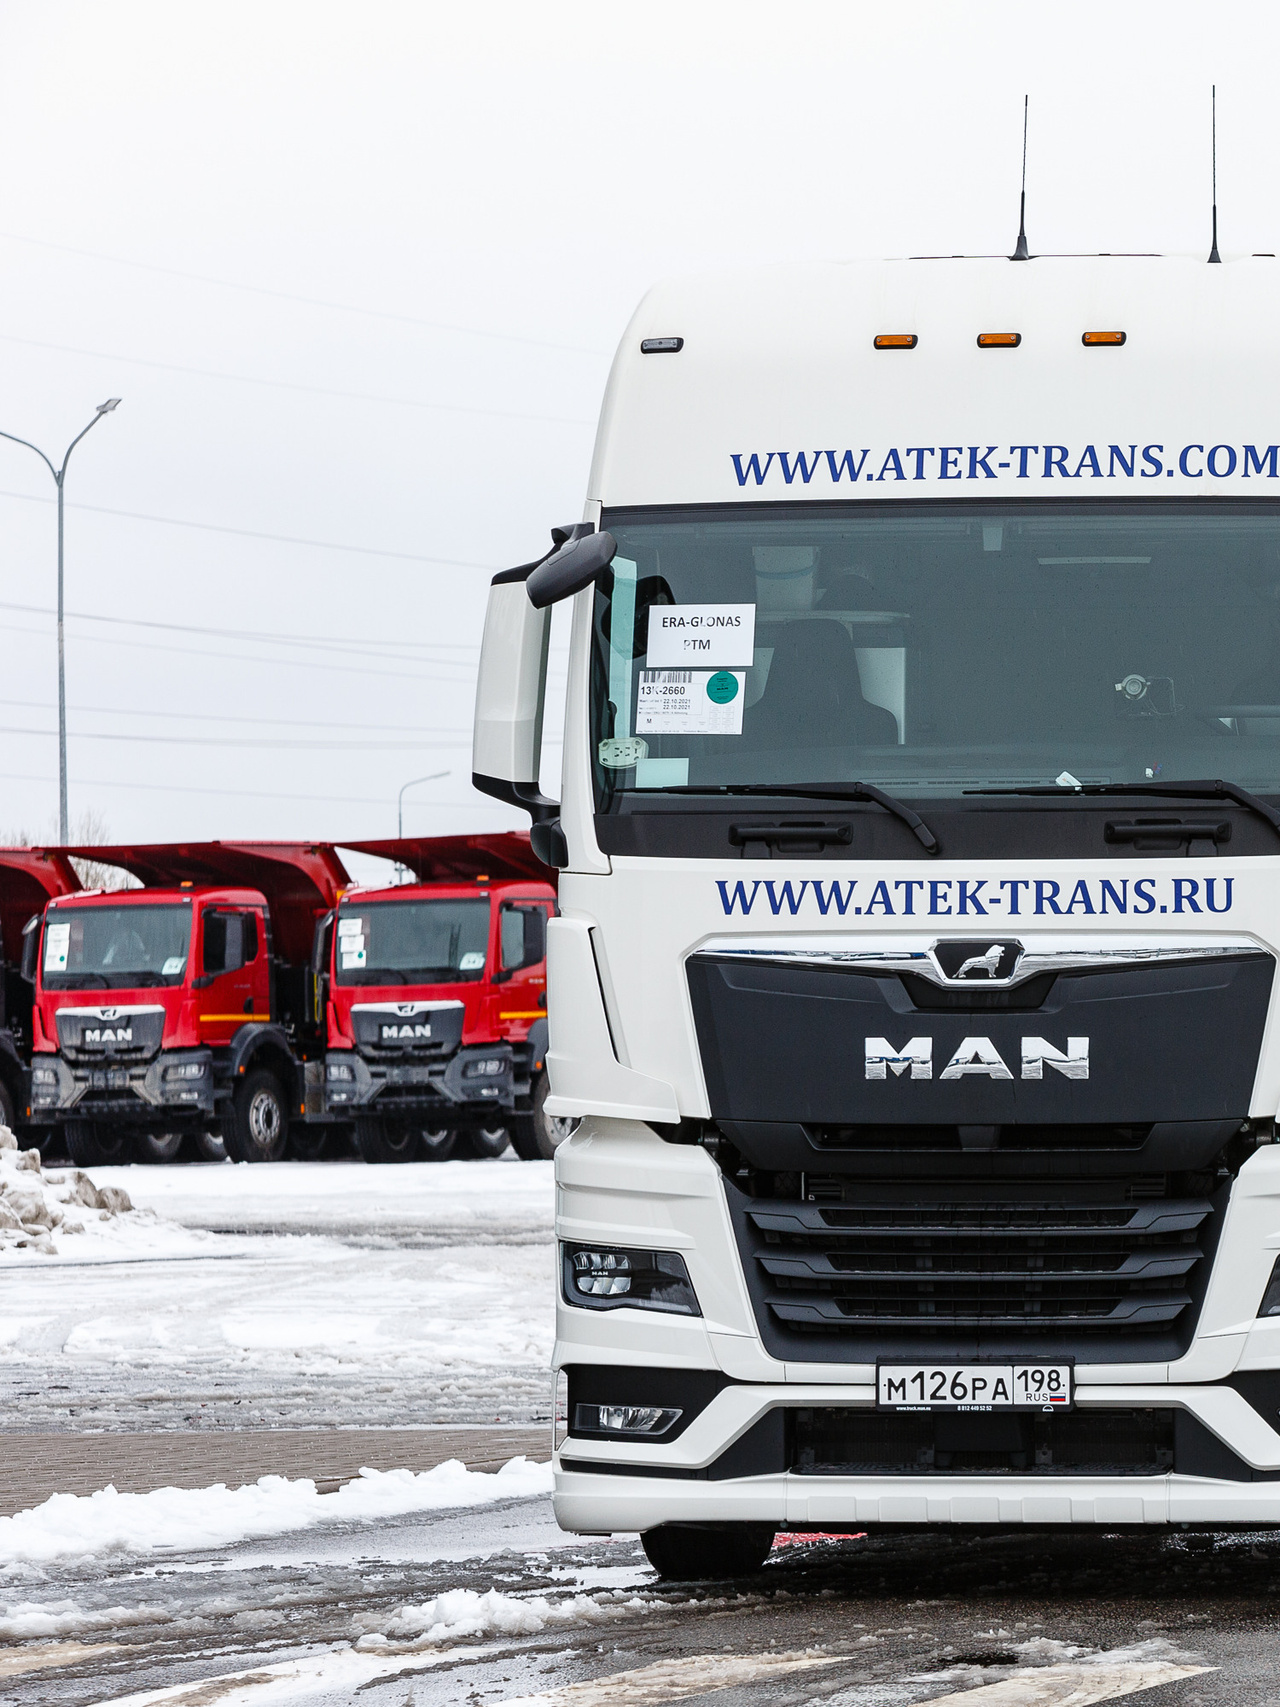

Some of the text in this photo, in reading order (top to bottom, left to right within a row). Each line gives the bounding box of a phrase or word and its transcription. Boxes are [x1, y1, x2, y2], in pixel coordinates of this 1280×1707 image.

[731, 445, 1280, 486] WWW.ATEK-TRANS.COM
[662, 616, 741, 628] ERA-GLONAS
[684, 639, 711, 651] PTM
[715, 877, 1235, 916] WWW.ATEK-TRANS.RU
[84, 1028, 133, 1042] MAN
[382, 1024, 432, 1039] MAN
[864, 1036, 1090, 1080] MAN
[1017, 1369, 1061, 1392] 198
[1025, 1393, 1049, 1402] RUS
